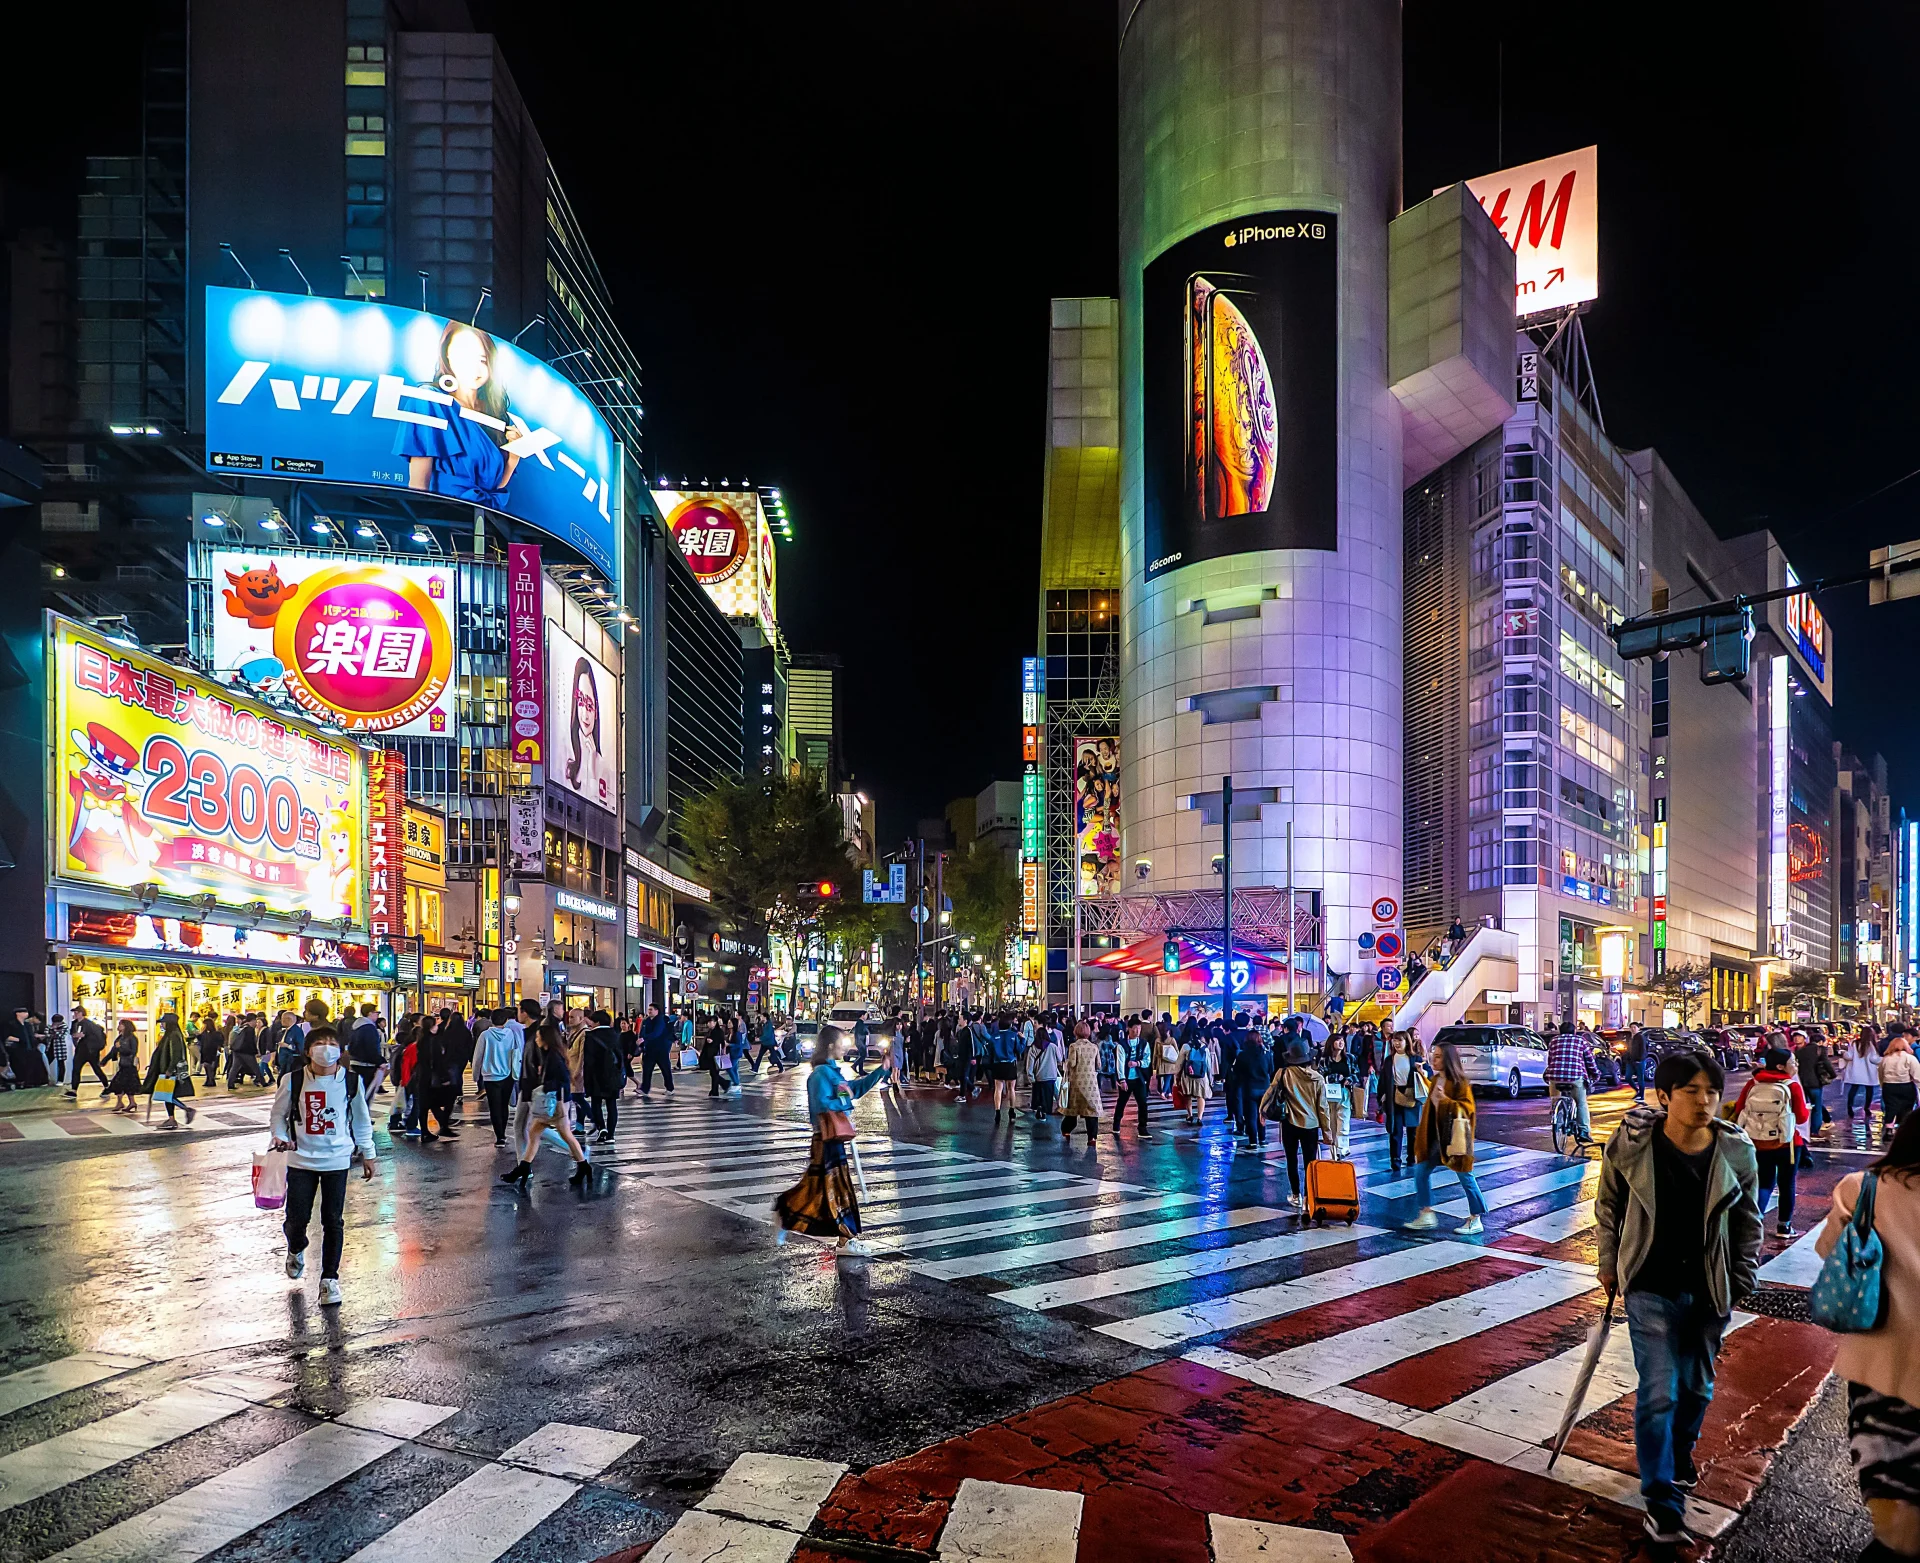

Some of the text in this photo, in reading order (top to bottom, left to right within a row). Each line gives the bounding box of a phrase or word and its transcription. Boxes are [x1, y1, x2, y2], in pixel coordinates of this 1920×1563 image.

[1239, 225, 1295, 245] iPhone
[217, 360, 611, 523] ハッピーメール
[227, 454, 256, 463] App Store
[286, 460, 304, 468] Google
[678, 526, 736, 557] 楽園
[699, 554, 745, 584] AMUSEMENT
[1149, 551, 1182, 572] docomo
[303, 619, 427, 679] 楽園
[515, 572, 538, 699] 品川美容外科
[75, 641, 351, 786] 日本最大級の超大型店
[353, 676, 444, 730] AMUSEMENT
[431, 714, 444, 722] 30
[143, 733, 307, 853] 2300
[371, 750, 387, 817] パチンコ
[301, 810, 320, 843] 台
[371, 821, 389, 916] エスパス
[1024, 869, 1036, 926] HOOTERS
[1377, 903, 1393, 916] 30
[507, 940, 515, 952] 3
[76, 978, 108, 999] 無双
